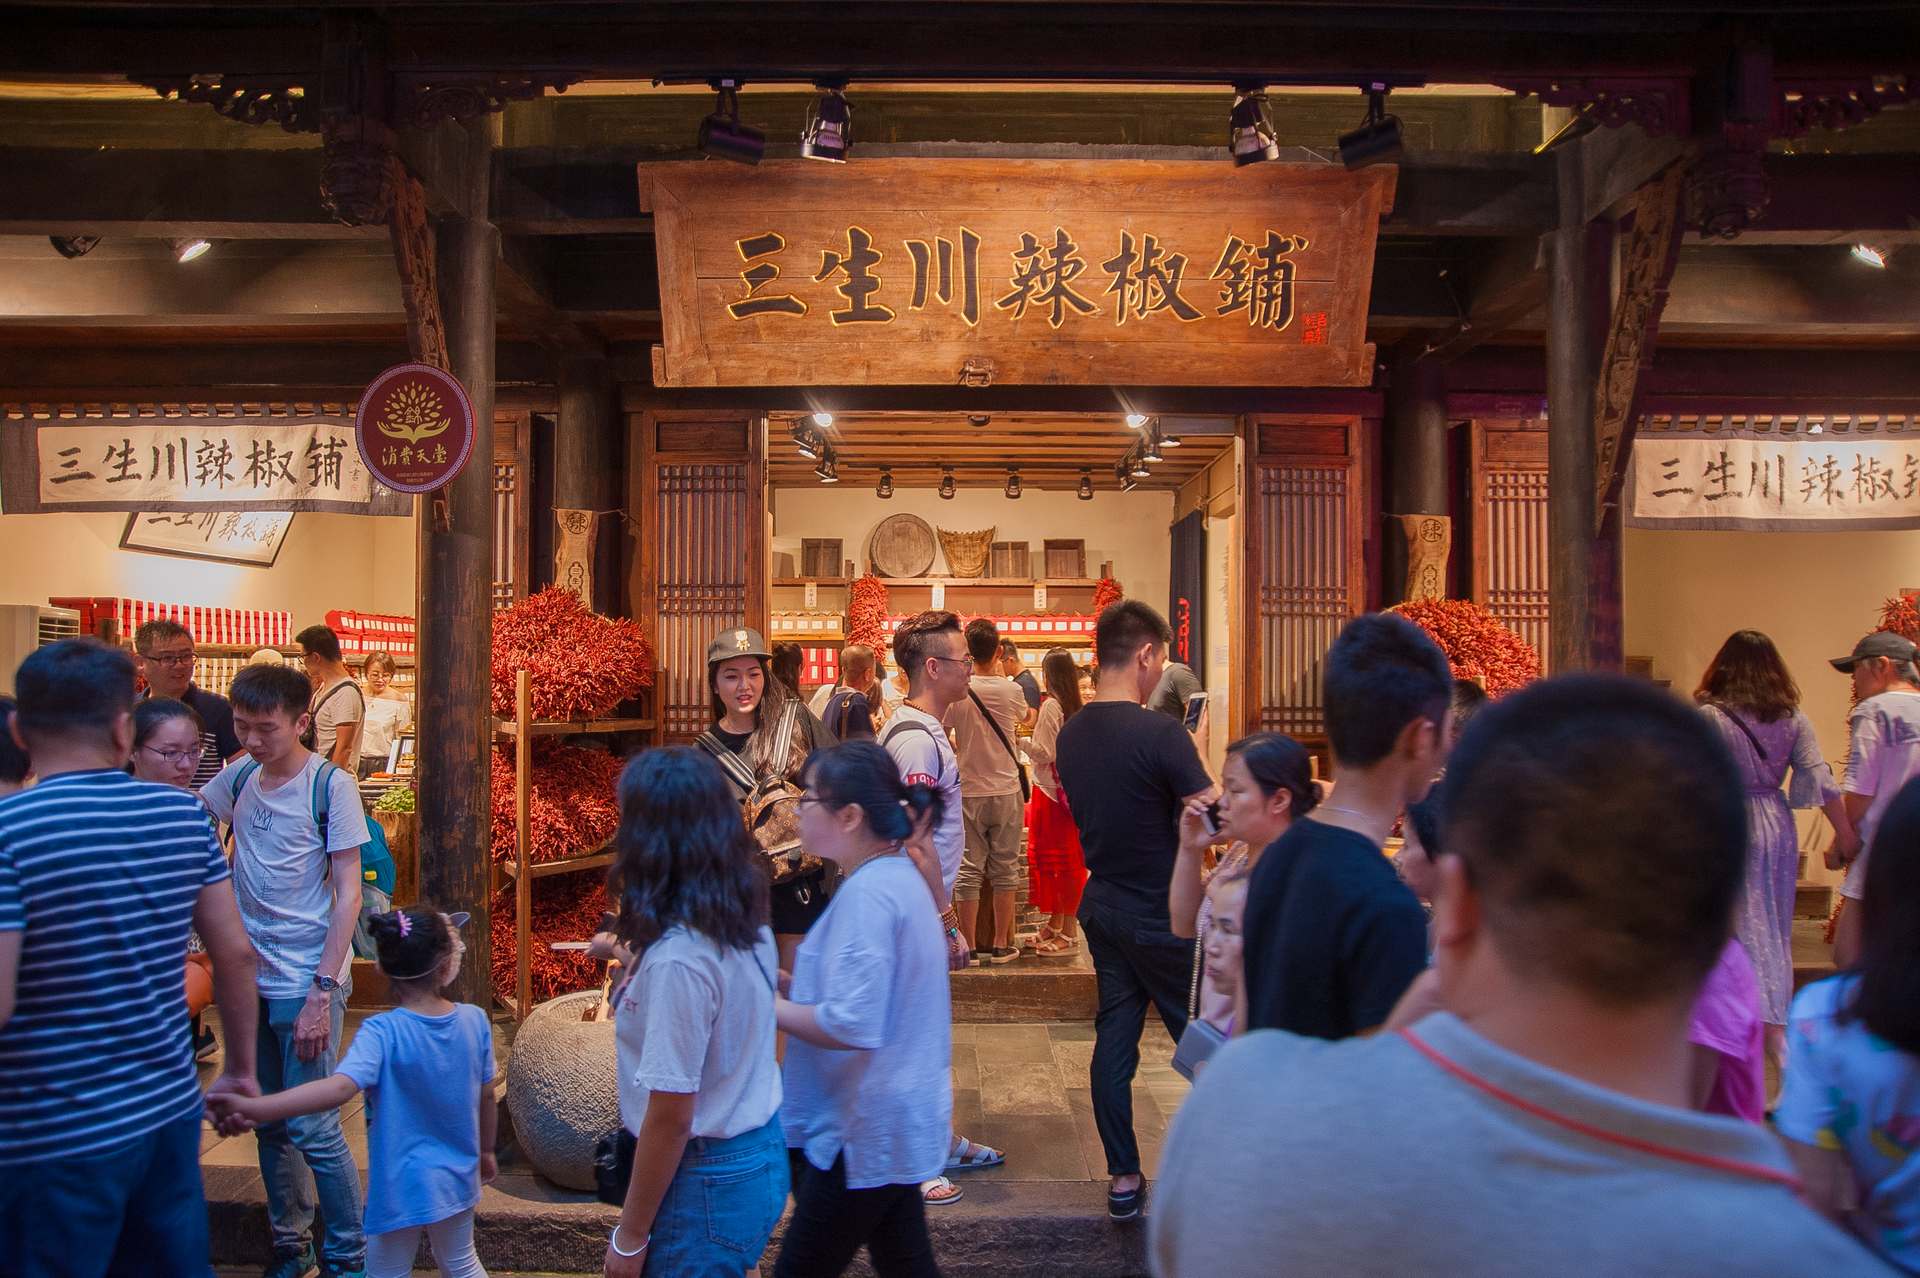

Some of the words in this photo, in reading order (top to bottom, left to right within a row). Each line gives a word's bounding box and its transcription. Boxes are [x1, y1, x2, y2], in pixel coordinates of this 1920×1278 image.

[726, 225, 1310, 333] 三生川辣椒鋪
[48, 435, 348, 490] 三生川辣椒铺
[381, 443, 447, 466] 消費天堂
